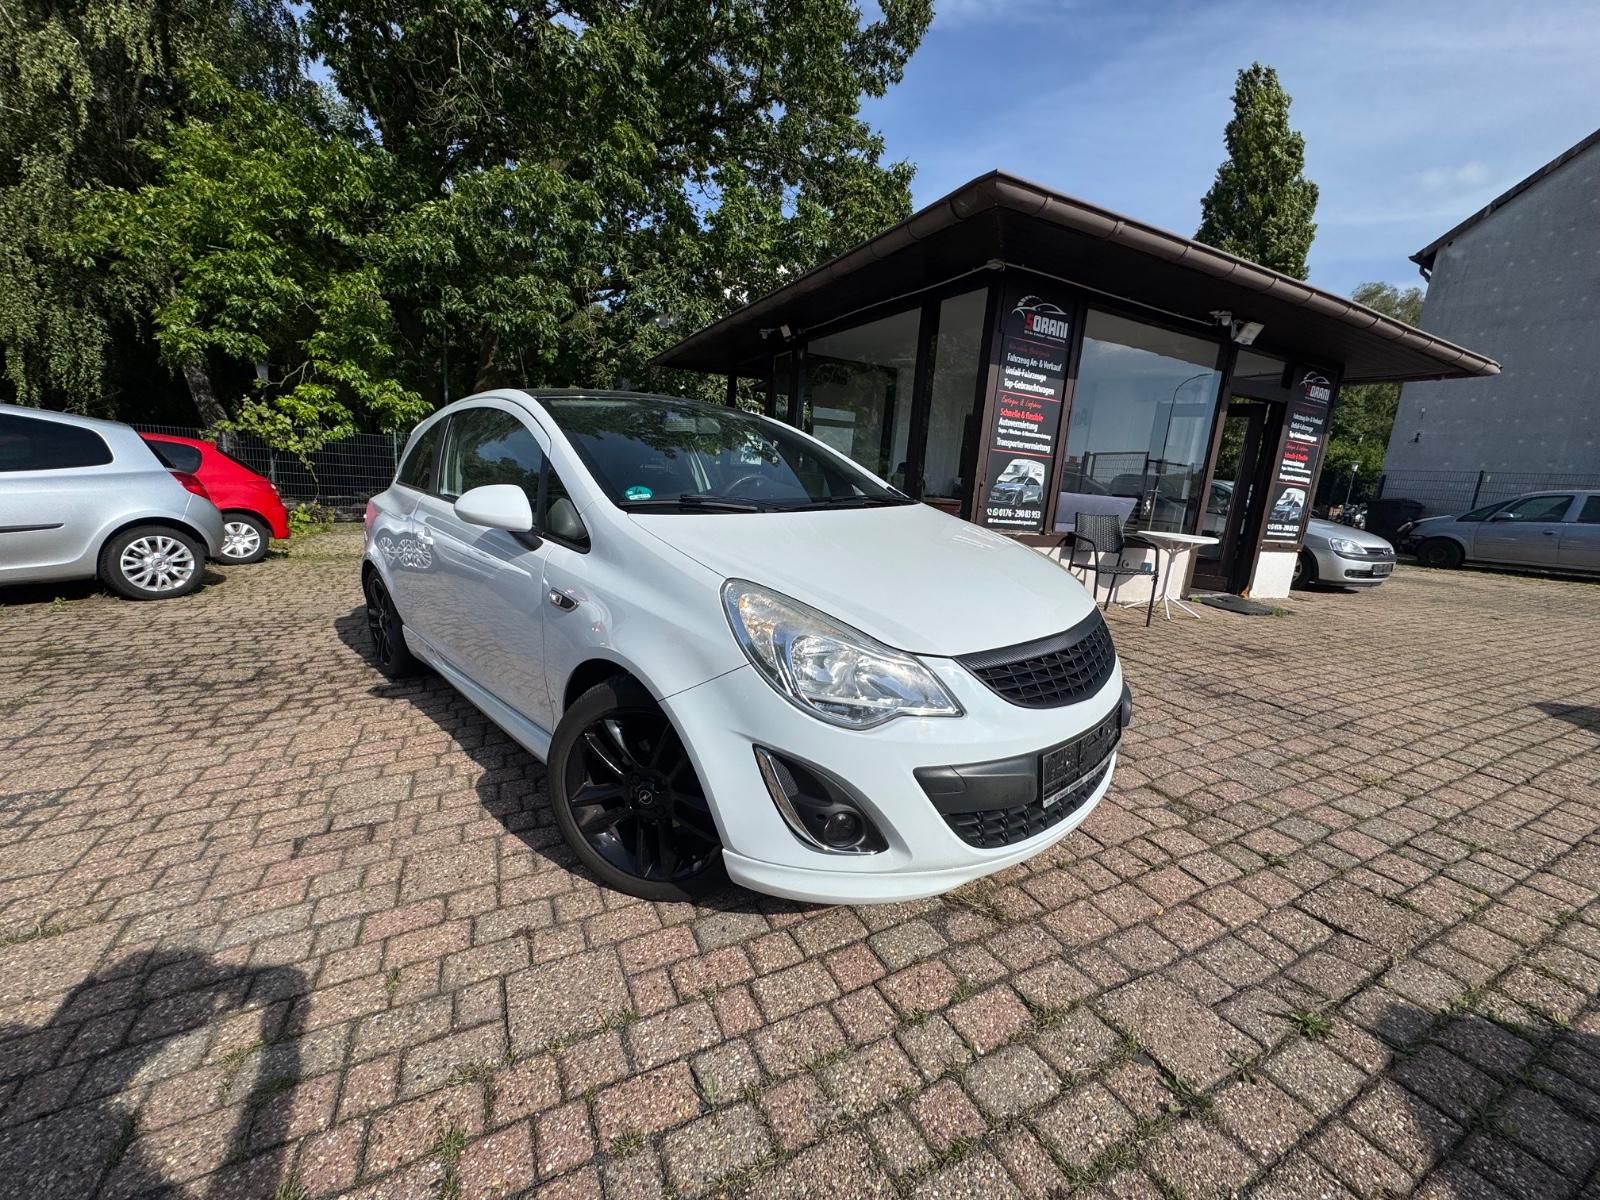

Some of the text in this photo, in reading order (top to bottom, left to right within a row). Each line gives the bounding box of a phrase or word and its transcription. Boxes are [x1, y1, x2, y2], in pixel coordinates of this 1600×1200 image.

[1024, 312, 1069, 338] SORANI
[1007, 353, 1030, 367] Fahrzeug
[1044, 361, 1062, 372] Verkauf
